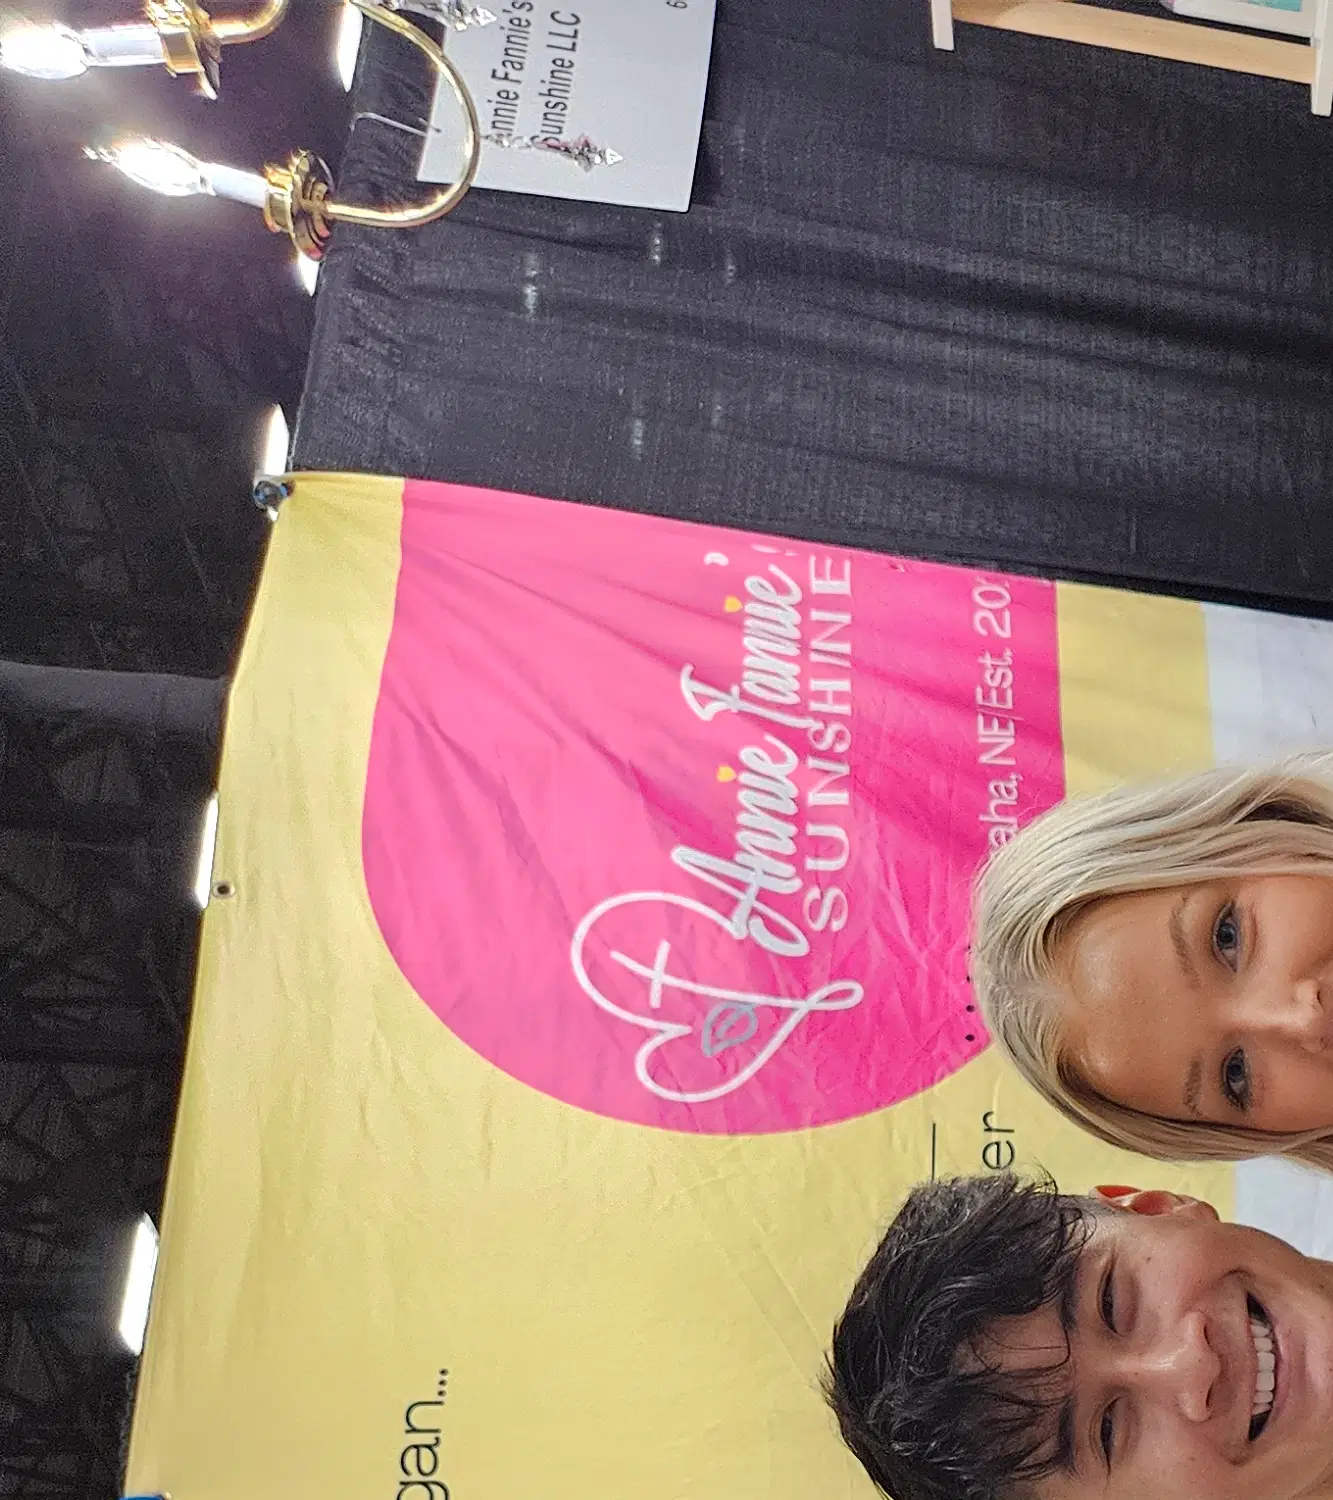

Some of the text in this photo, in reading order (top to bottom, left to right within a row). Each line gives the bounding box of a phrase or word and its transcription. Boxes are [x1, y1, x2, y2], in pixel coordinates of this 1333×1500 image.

[487, 0, 534, 138] nnie Fannie's
[546, 10, 581, 53] LLC
[972, 576, 1012, 639] 20
[671, 544, 824, 957] Annie Fannie'
[803, 553, 852, 932] SUNSHINE
[979, 773, 1023, 847] aha,
